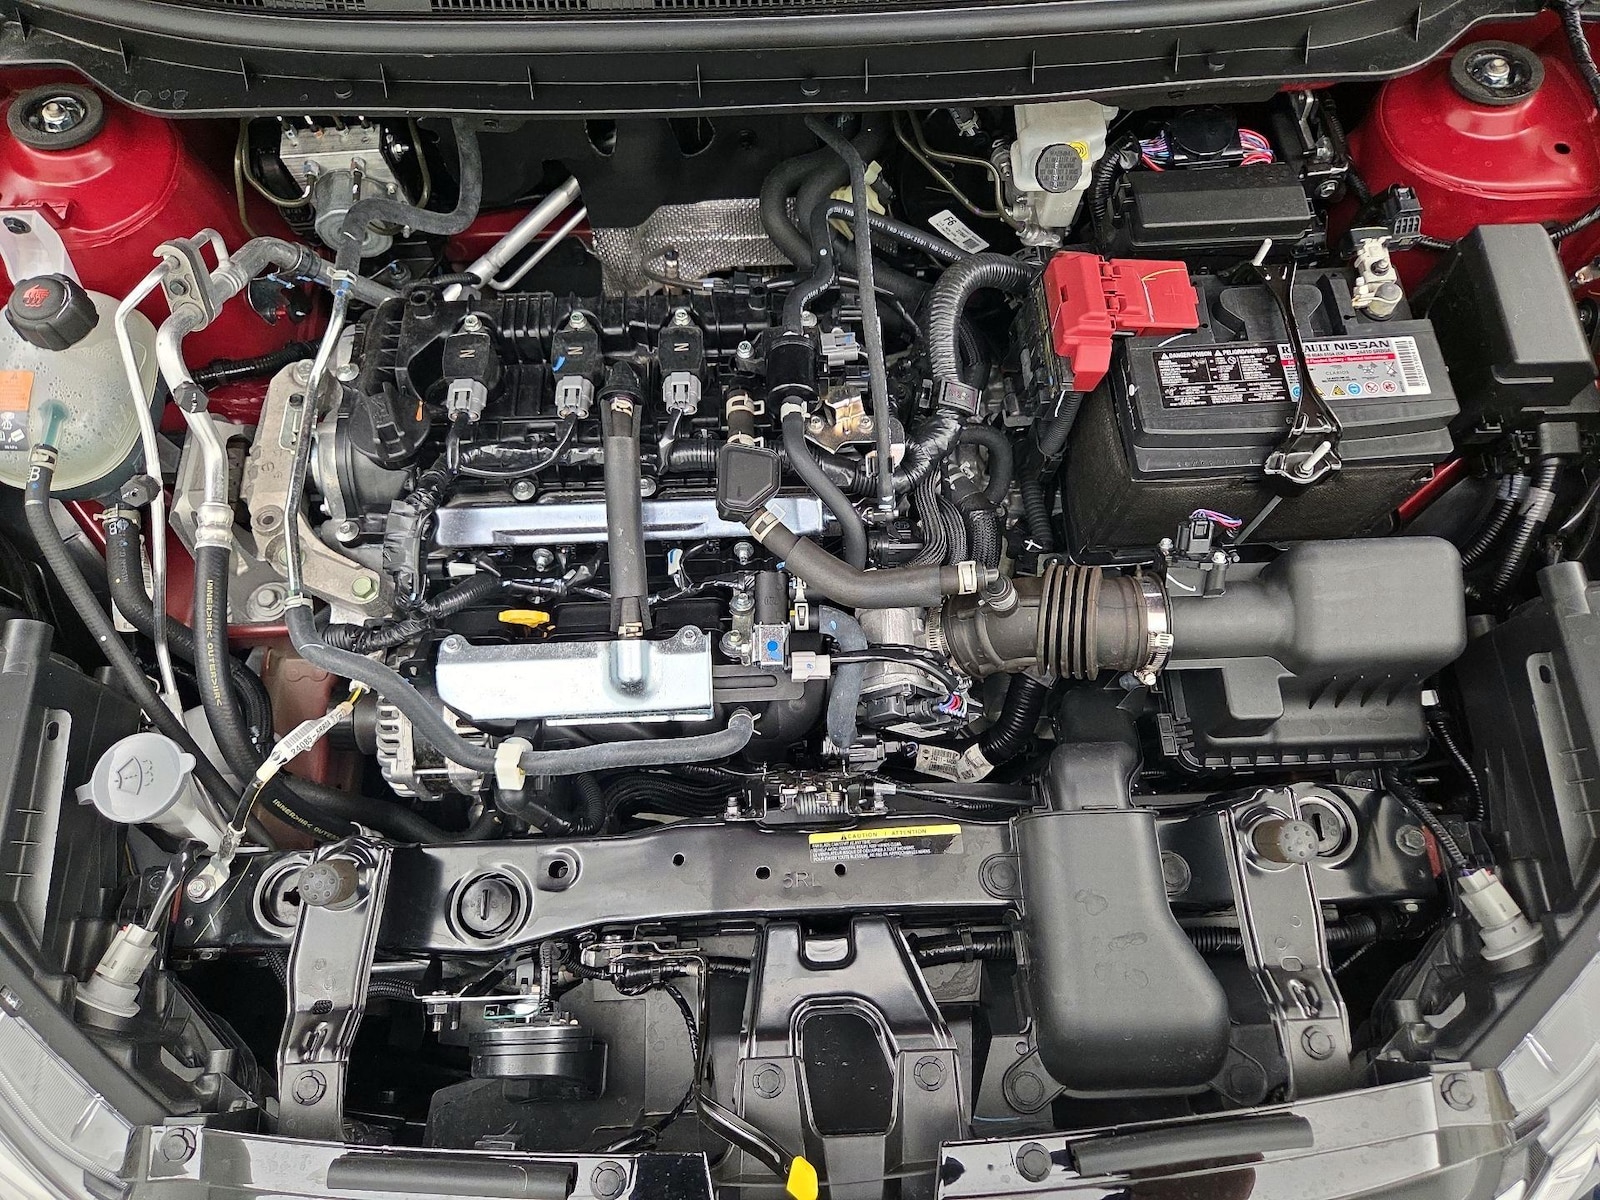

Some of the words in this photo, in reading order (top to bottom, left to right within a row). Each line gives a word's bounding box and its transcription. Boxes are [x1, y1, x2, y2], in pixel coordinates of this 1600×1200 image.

[943, 216, 957, 226] F6
[1334, 340, 1390, 351] NISSAN
[29, 466, 41, 481] B
[847, 831, 878, 839] CAUTION
[891, 828, 927, 836] ATTENTION
